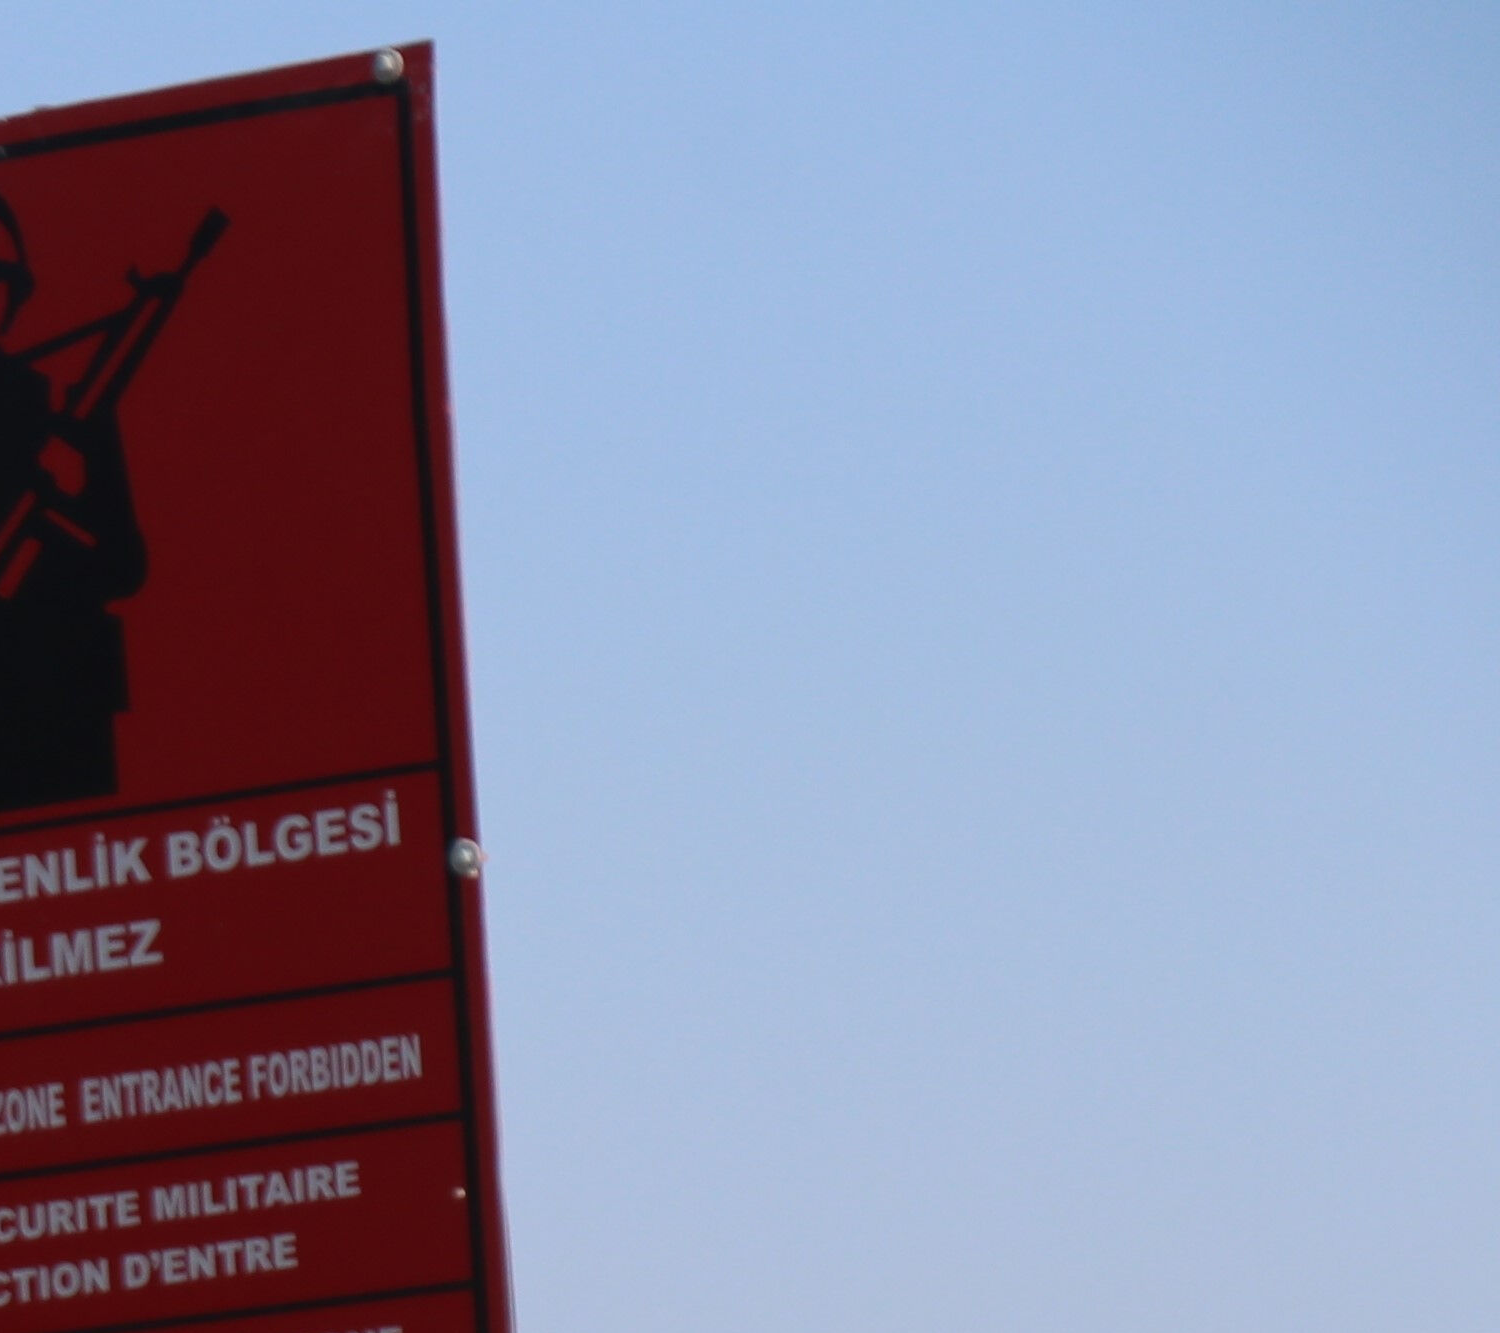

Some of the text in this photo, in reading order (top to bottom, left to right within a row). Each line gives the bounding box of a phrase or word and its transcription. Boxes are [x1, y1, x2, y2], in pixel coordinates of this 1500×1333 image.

[166, 790, 401, 878] BÖLGESİ
[81, 1059, 242, 1123] ENTRANCE
[249, 1034, 422, 1099] FORBIDDEN
[152, 1162, 361, 1221] MILITAIRE
